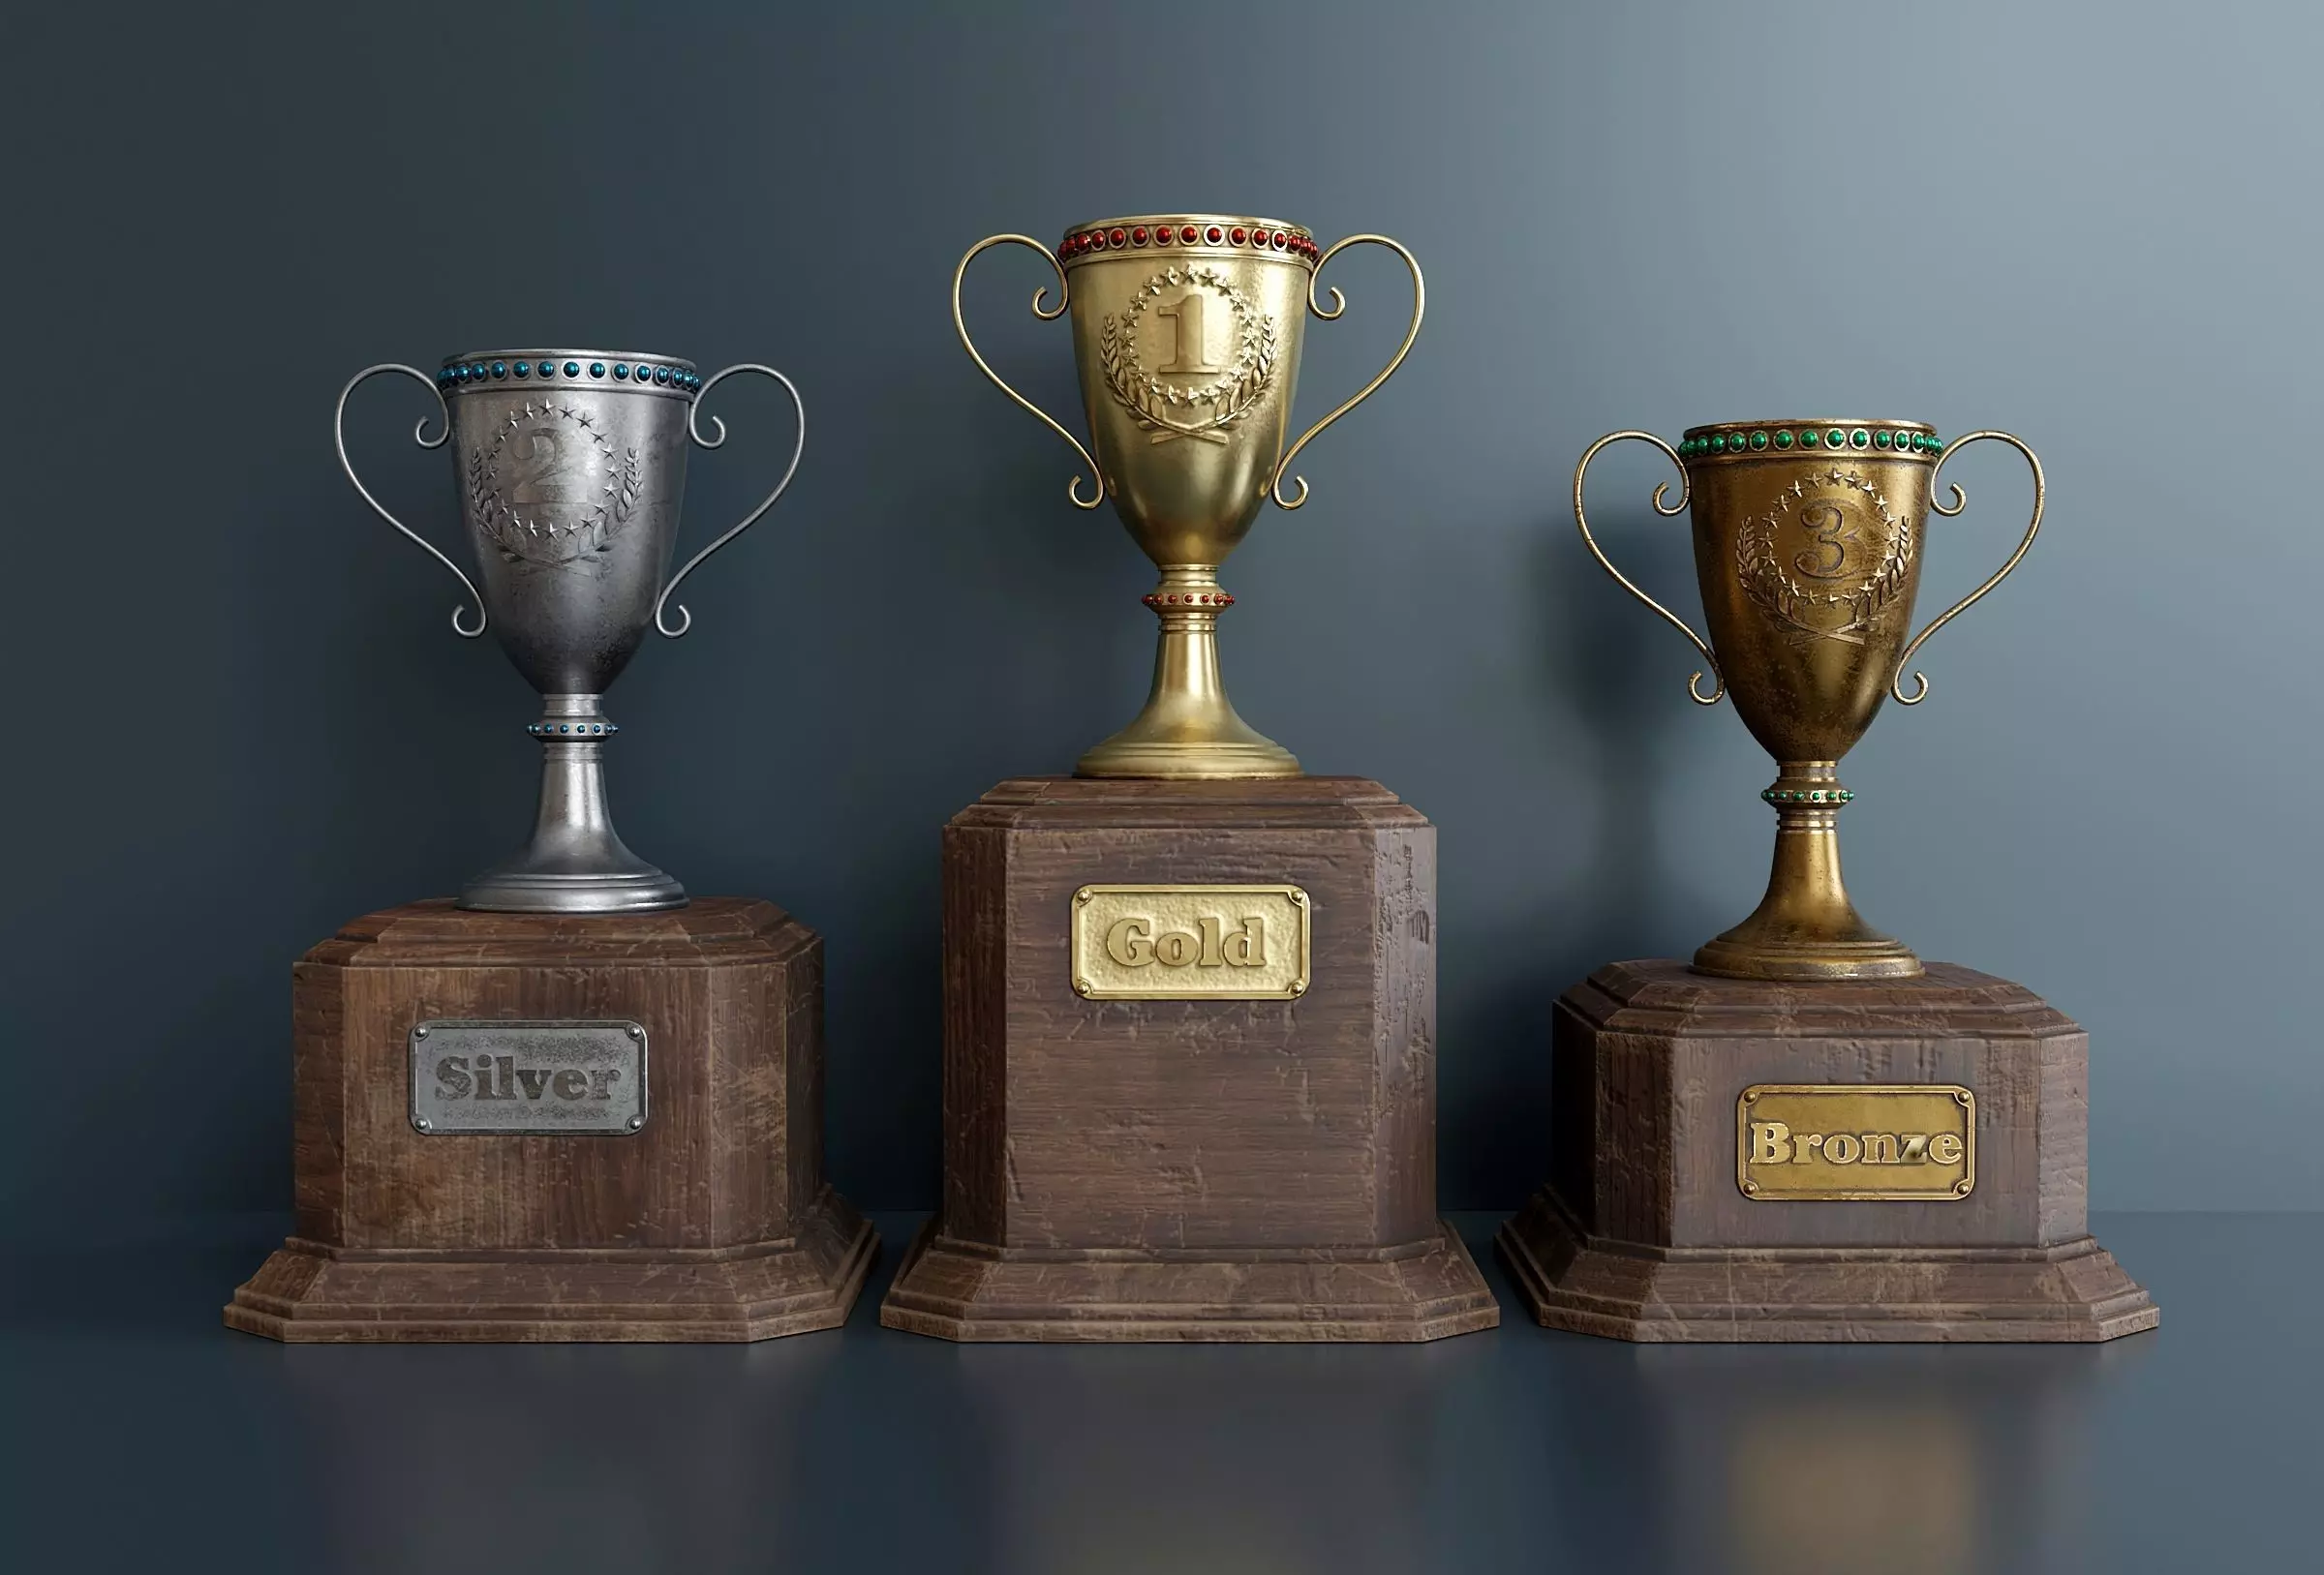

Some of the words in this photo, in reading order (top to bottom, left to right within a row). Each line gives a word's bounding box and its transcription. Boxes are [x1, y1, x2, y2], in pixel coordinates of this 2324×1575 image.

[1158, 294, 1221, 374] 1
[512, 427, 589, 503] 2
[1794, 499, 1867, 579] 3
[1107, 917, 1267, 967] Gold
[434, 1054, 621, 1101] Silver
[1749, 1122, 1963, 1165] Bronze
